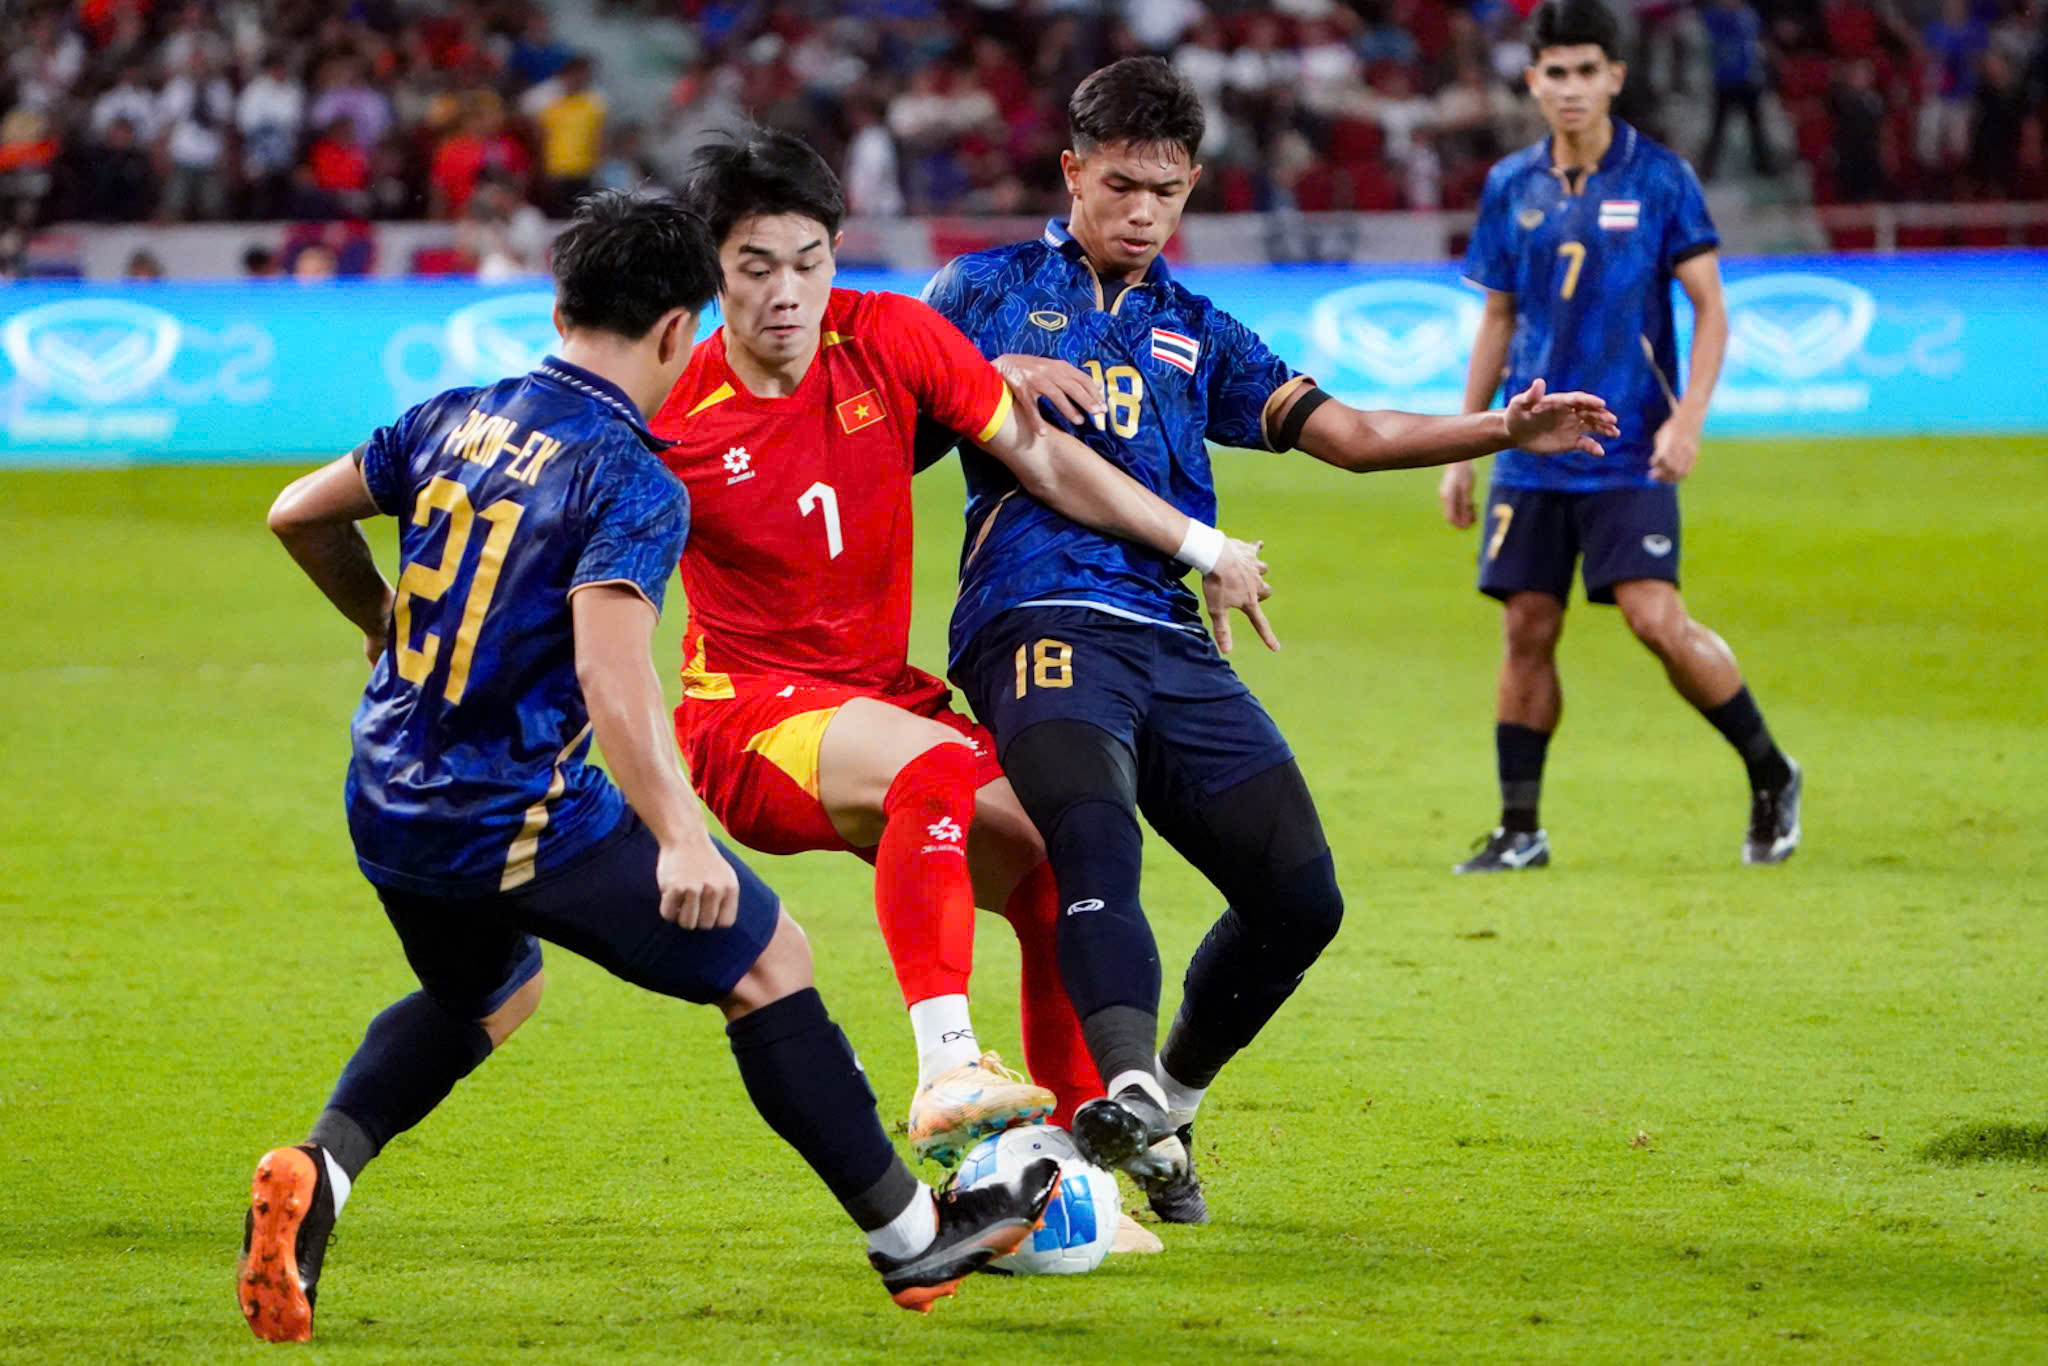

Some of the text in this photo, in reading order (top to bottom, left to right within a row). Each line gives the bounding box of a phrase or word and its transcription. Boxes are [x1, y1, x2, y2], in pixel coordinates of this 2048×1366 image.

[1558, 242, 1586, 301] 7
[1082, 360, 1144, 439] 18
[1488, 503, 1514, 562] 7
[394, 475, 525, 706] 21
[1015, 638, 1074, 700] 18
